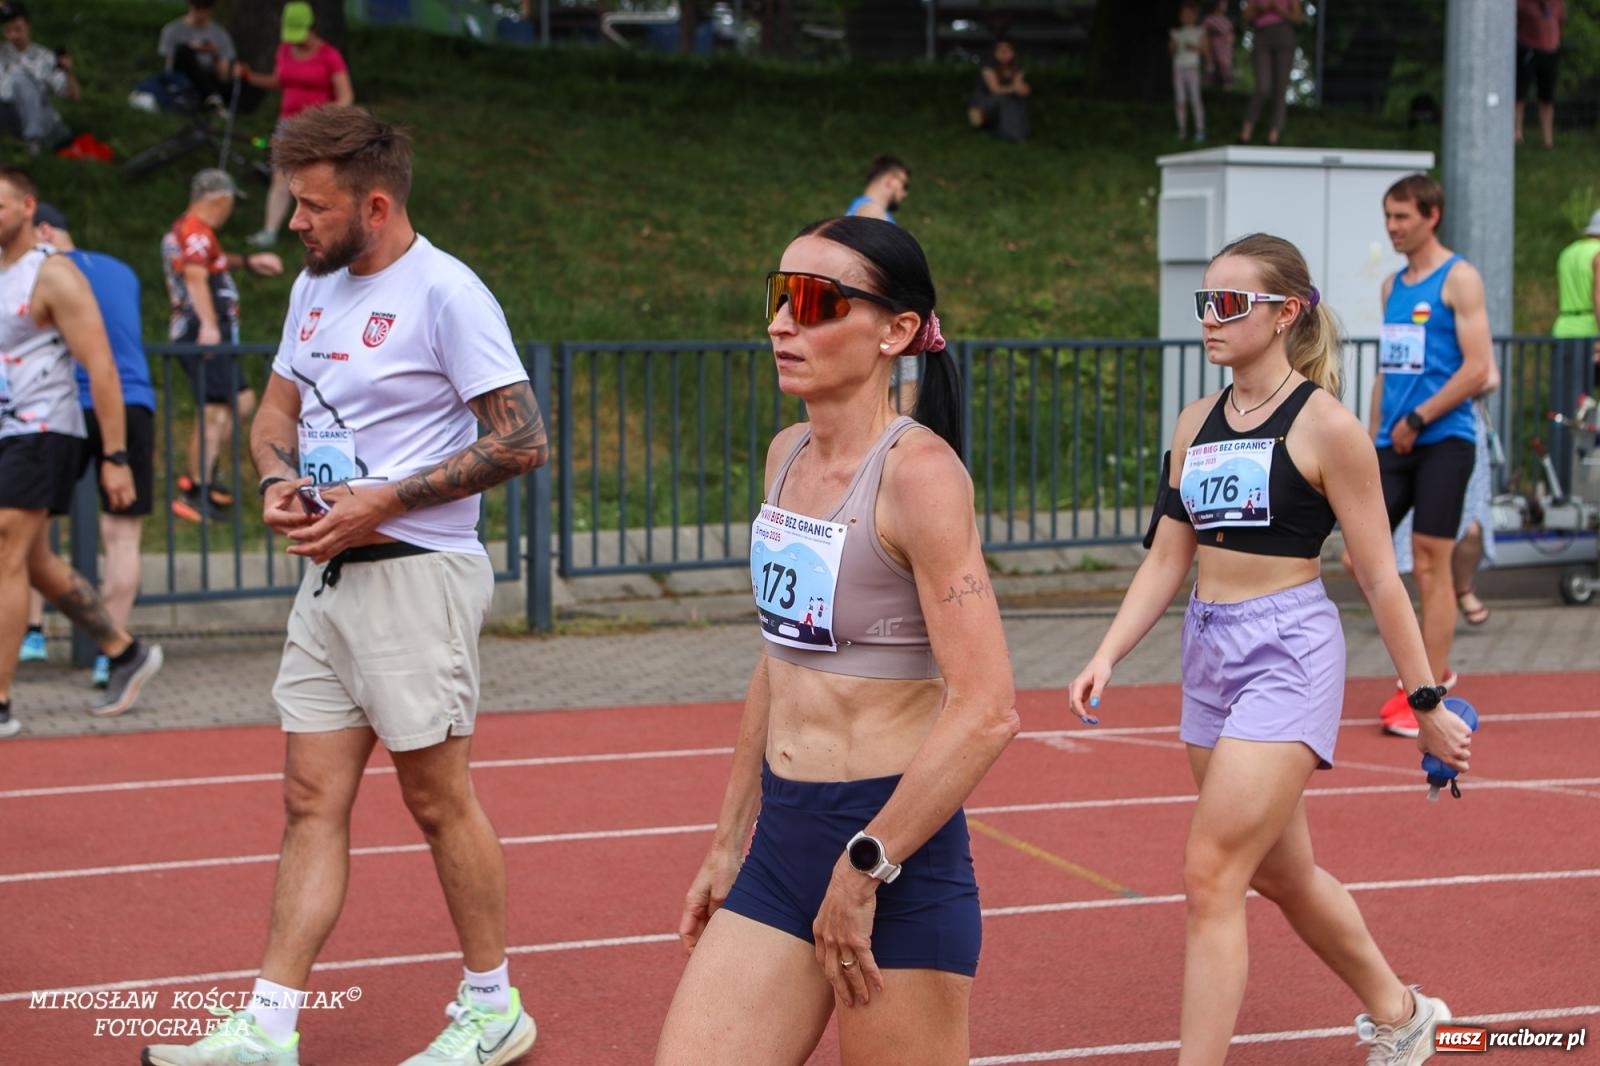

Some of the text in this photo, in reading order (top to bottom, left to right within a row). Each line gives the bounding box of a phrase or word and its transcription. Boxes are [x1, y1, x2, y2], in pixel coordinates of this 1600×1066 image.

[319, 430, 348, 439] GRANIC
[1203, 444, 1218, 455] BIEG
[1219, 443, 1233, 452] BEZ
[1234, 441, 1267, 451] GRANIC
[1199, 474, 1240, 505] 176
[770, 511, 785, 525] BIEG
[784, 515, 798, 530] BEZ
[798, 520, 834, 539] GRANIC
[769, 531, 781, 542] 2025
[762, 561, 797, 610] 173
